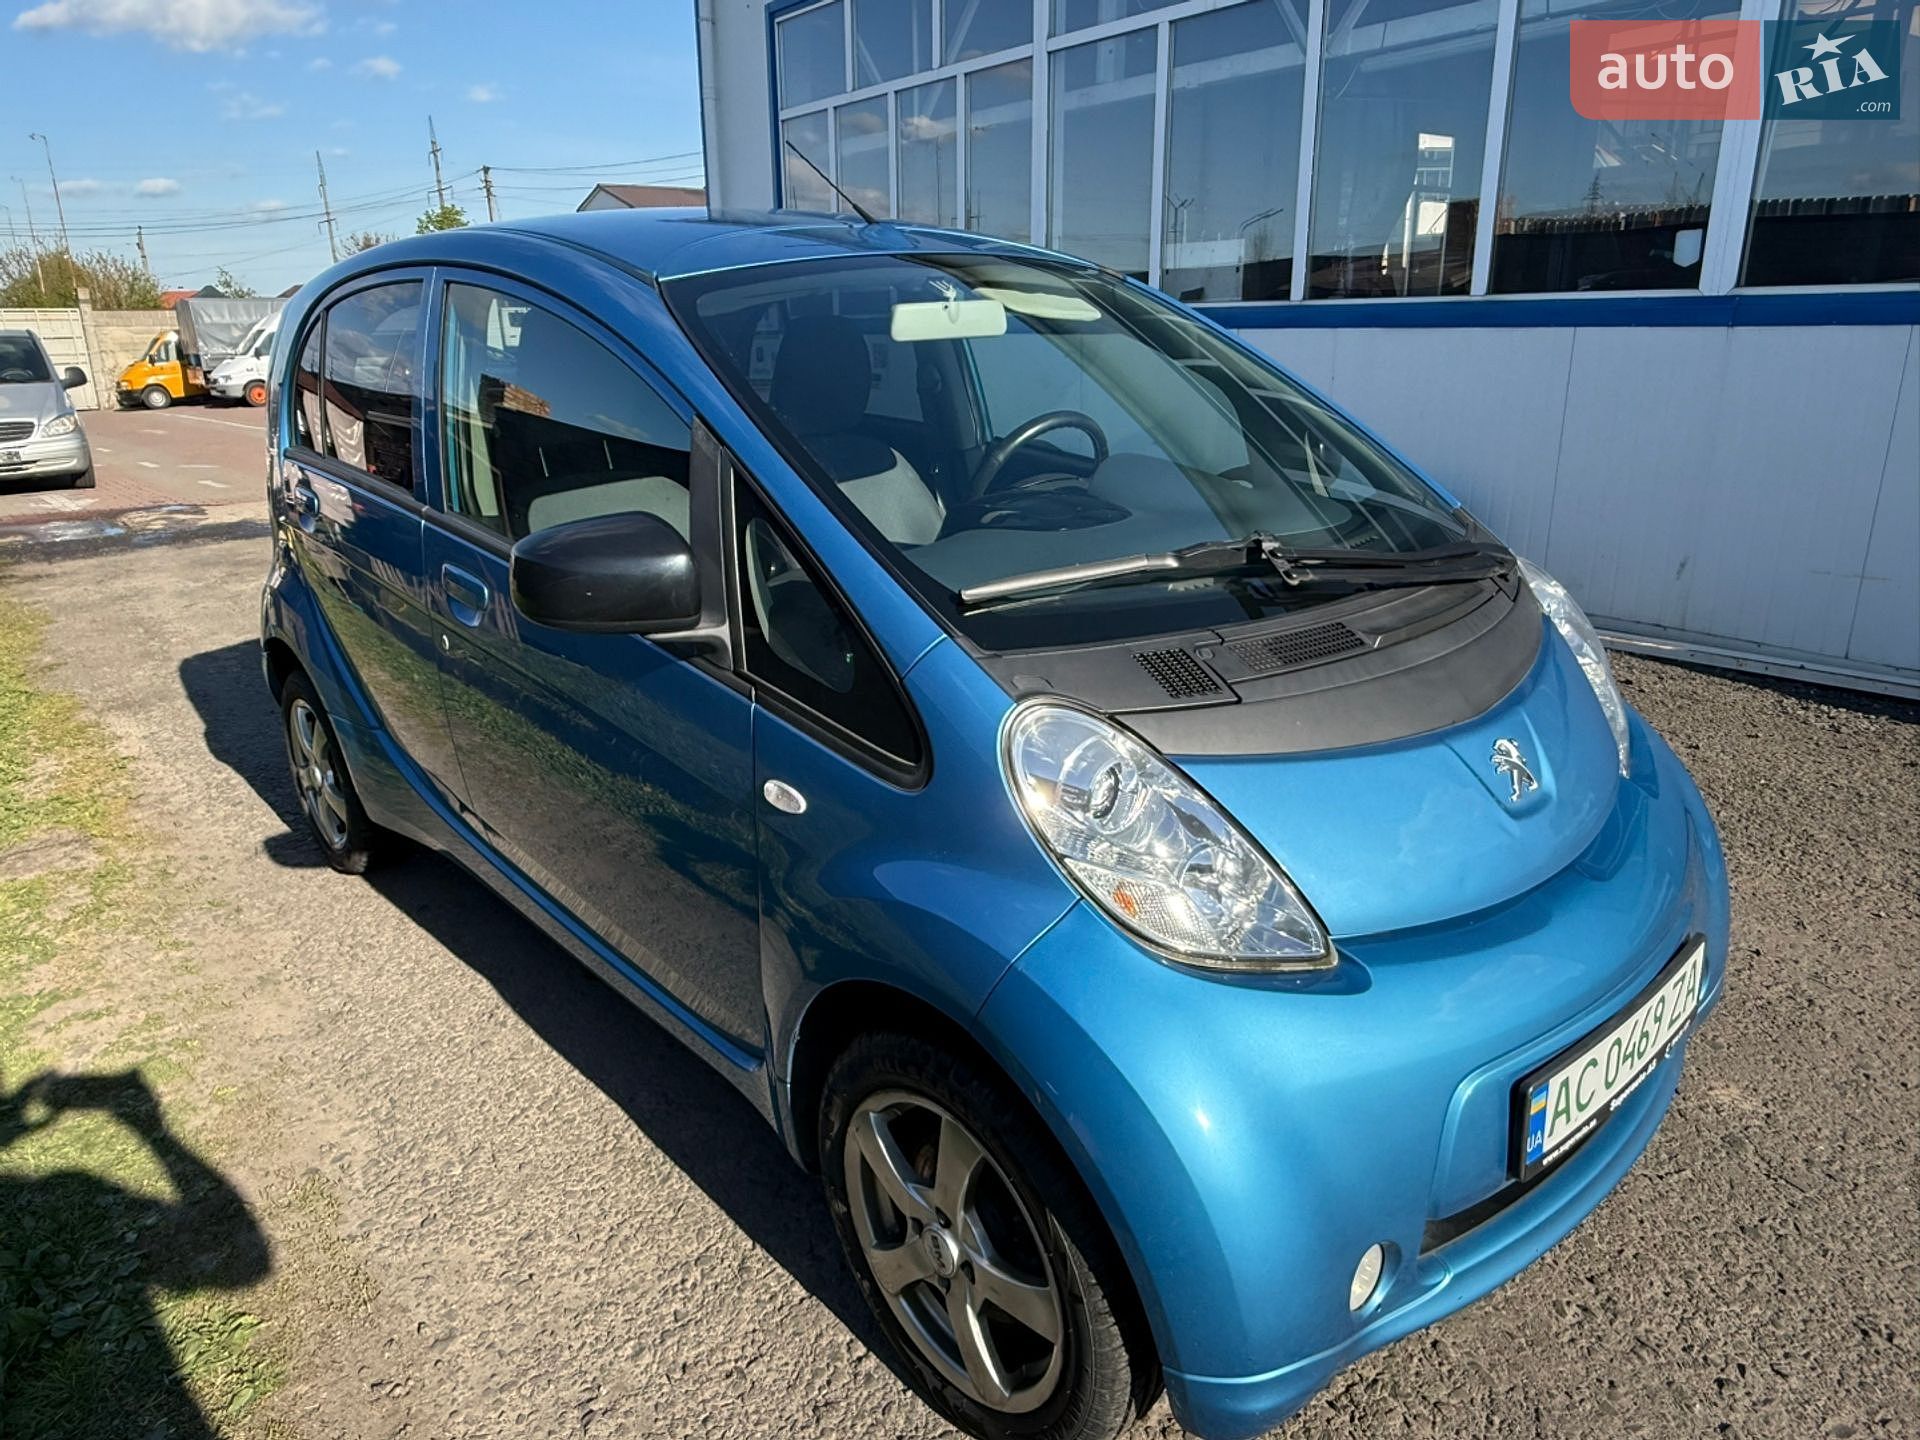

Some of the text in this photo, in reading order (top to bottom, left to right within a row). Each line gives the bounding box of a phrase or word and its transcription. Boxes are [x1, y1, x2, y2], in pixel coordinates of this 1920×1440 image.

[1547, 1057, 1598, 1138] AC
[1604, 995, 1666, 1091] 0469
[1667, 959, 1698, 1032] ZA
[1527, 1129, 1543, 1153] UA
